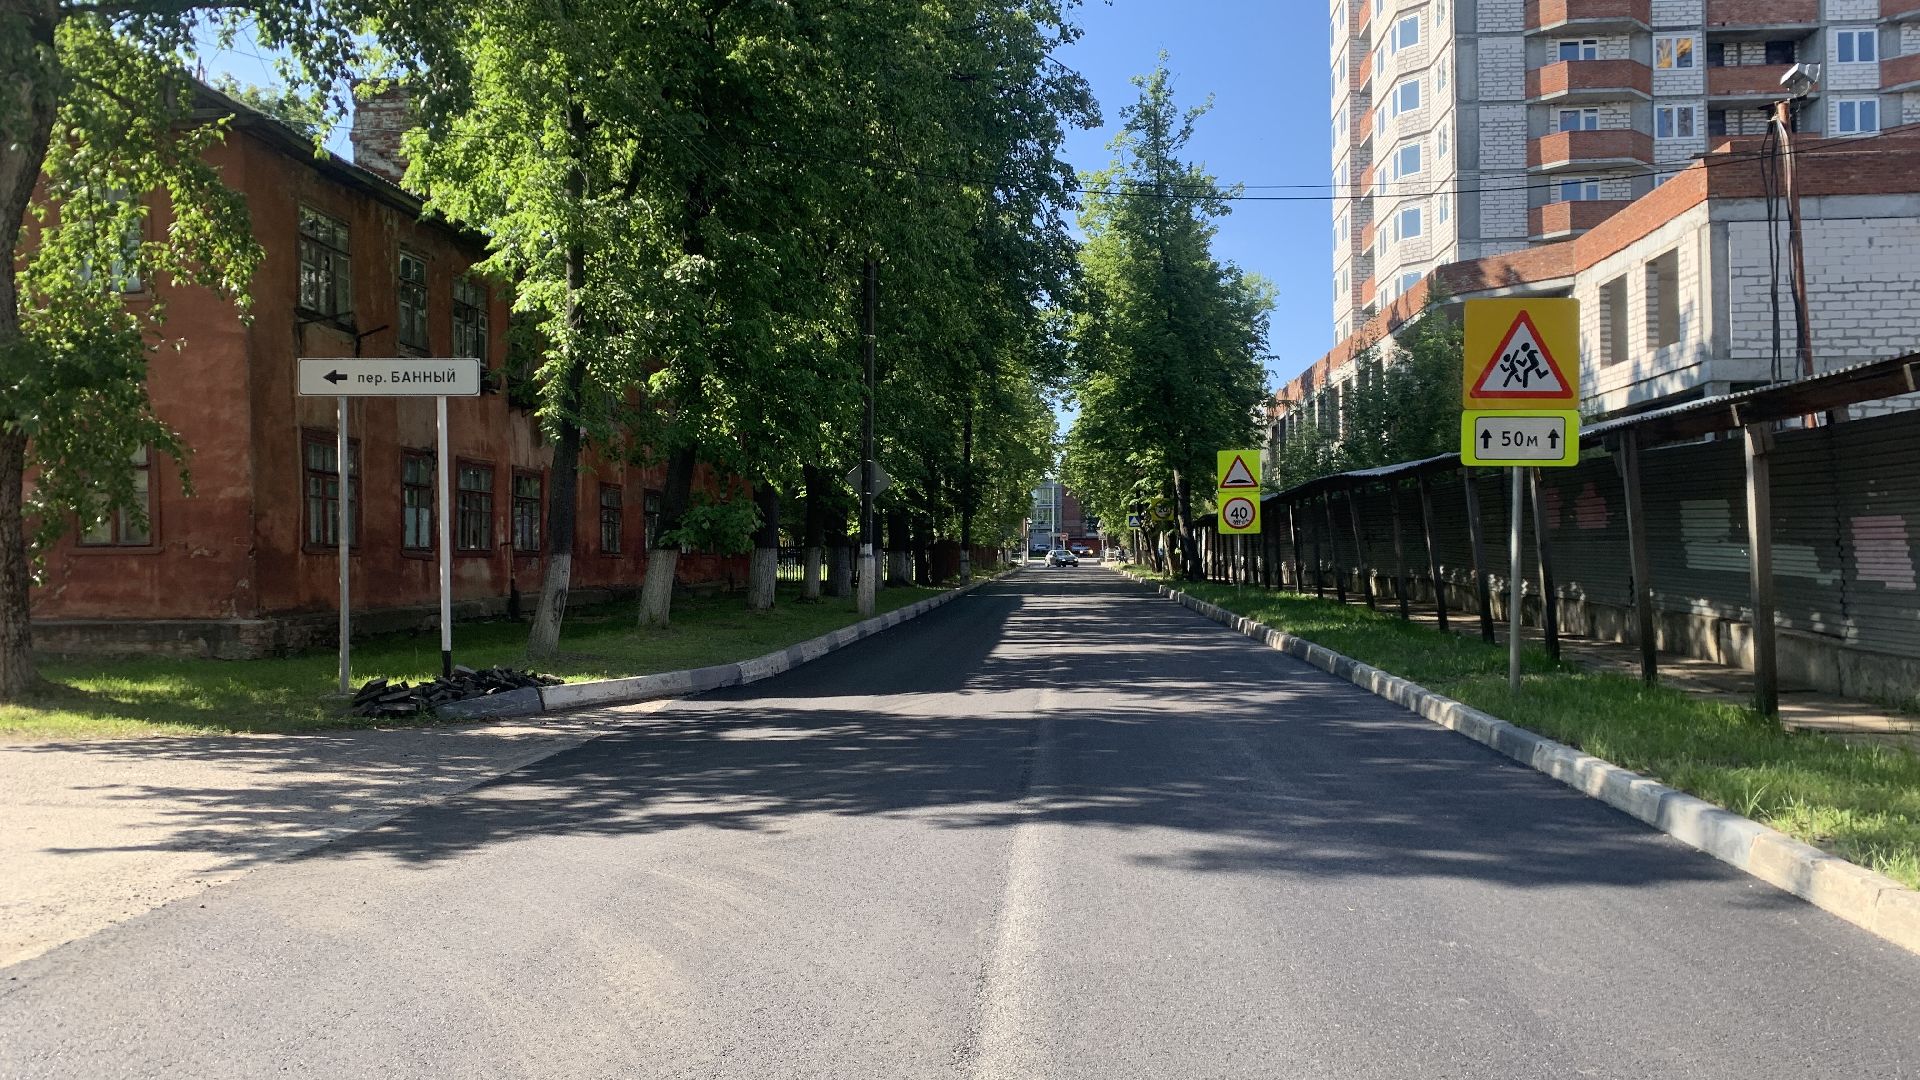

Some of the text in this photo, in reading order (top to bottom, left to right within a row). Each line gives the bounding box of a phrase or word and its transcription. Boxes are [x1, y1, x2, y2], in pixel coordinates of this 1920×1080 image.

[357, 368, 456, 386] пер. БАННЫЙ
[1230, 506, 1248, 519] 40
